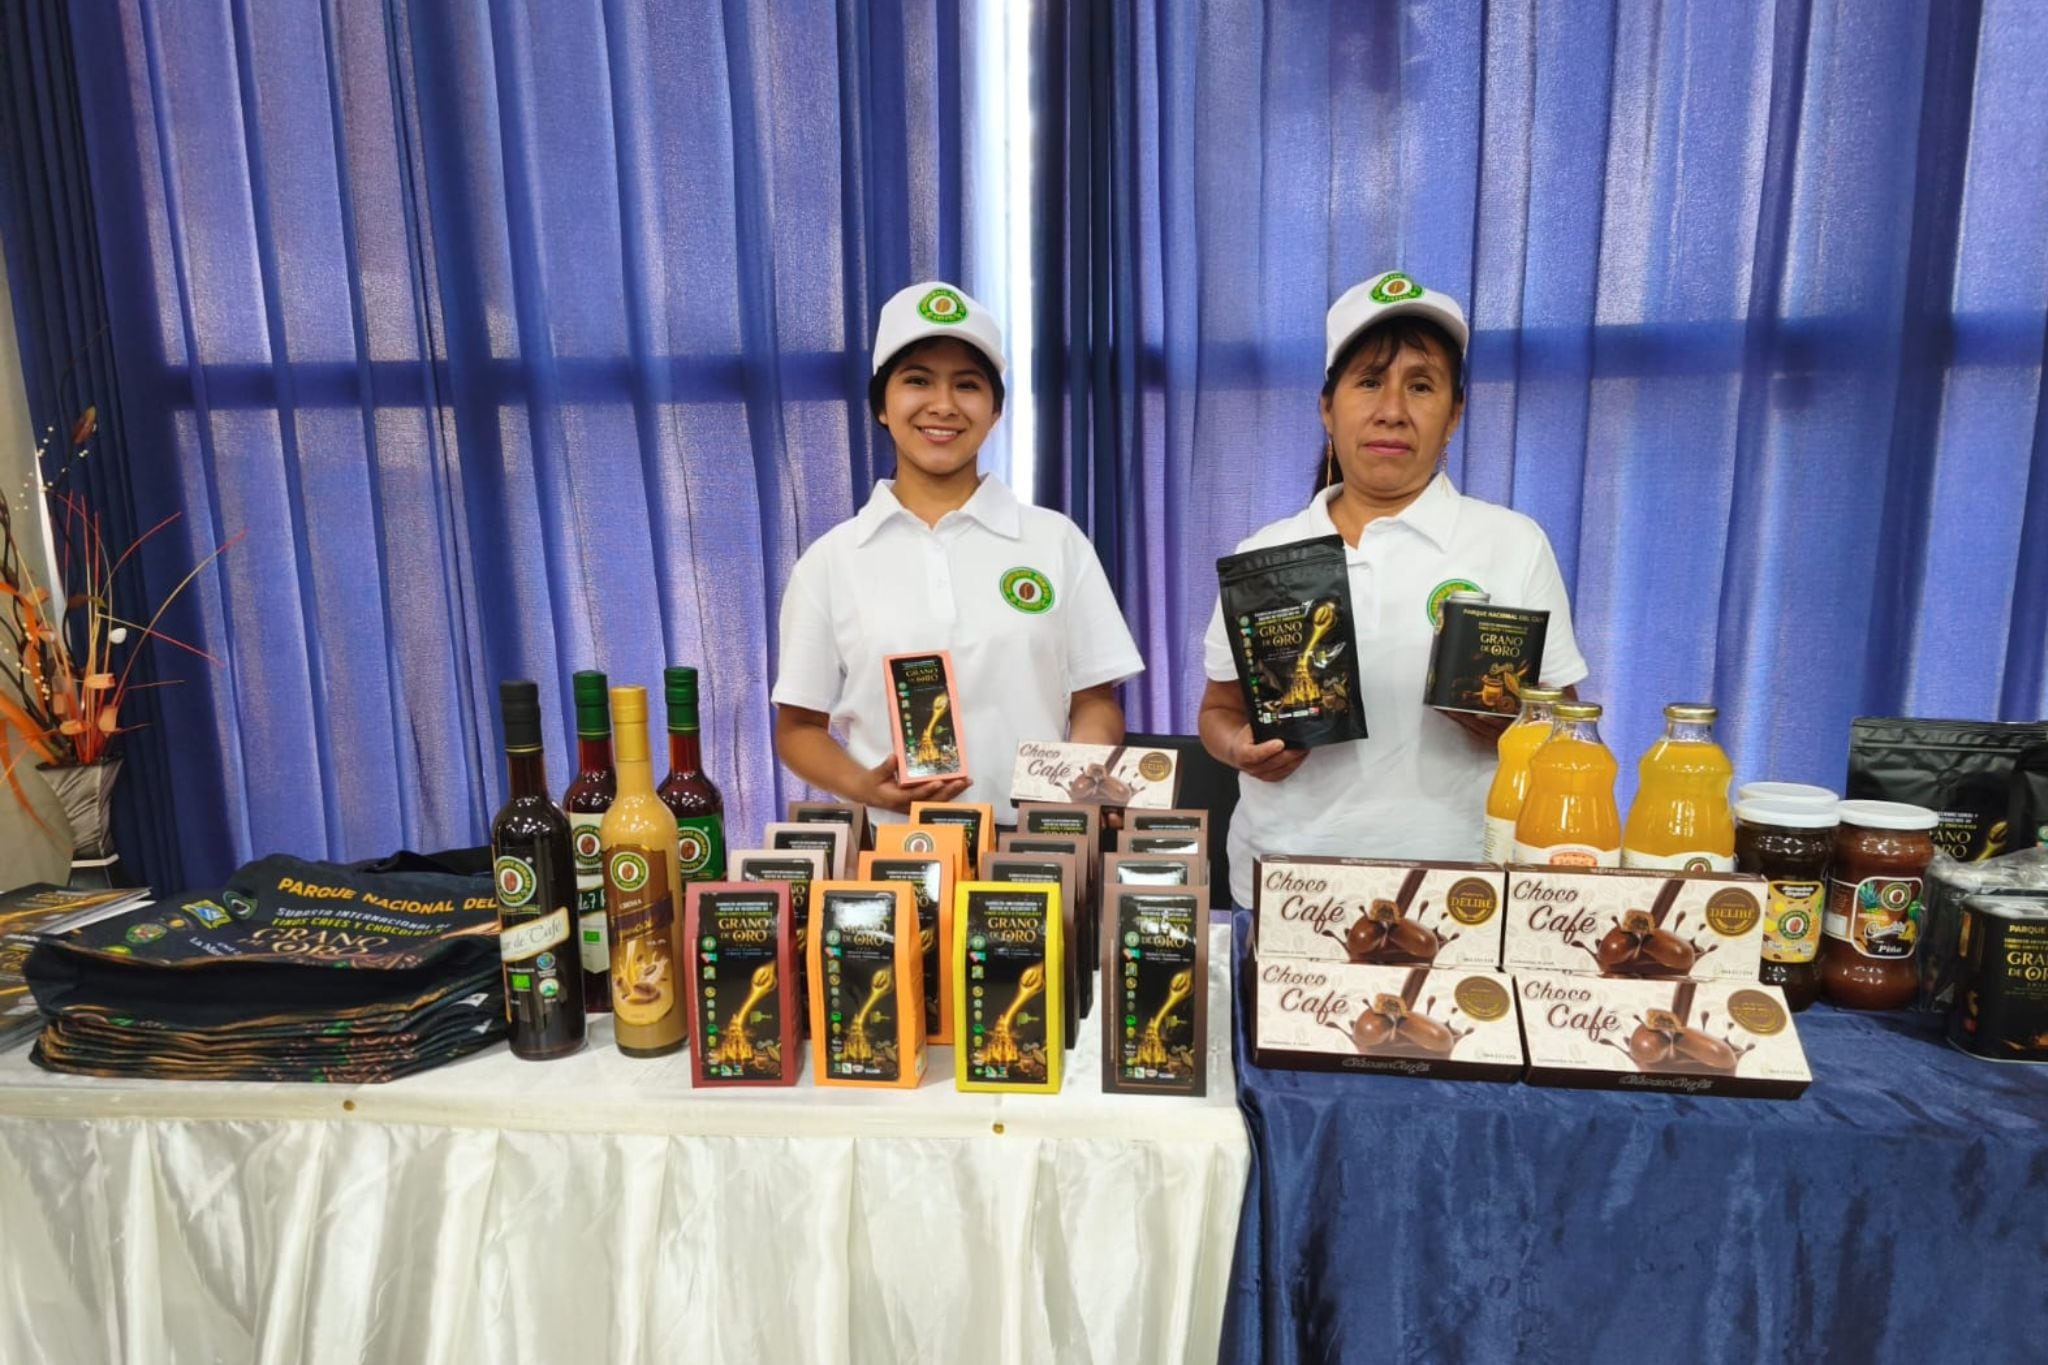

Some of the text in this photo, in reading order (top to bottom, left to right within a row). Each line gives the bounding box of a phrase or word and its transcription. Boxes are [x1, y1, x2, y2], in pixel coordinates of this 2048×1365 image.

[1259, 621, 1303, 637] GRANO
[1273, 631, 1303, 647] ORO
[1480, 633, 1523, 647] GRANO
[1491, 644, 1521, 658] ORO
[1019, 743, 1061, 759] Choco
[1027, 759, 1071, 786] Café
[1929, 830, 1971, 844] ANO
[1265, 871, 1328, 892] Choco
[278, 877, 357, 899] PARQUE
[362, 892, 455, 915] NACIONAL
[462, 897, 498, 910] DEL
[1513, 879, 1578, 902] Choco
[1280, 894, 1346, 934] Café
[353, 921, 362, 930] Y
[718, 917, 769, 930] GRANO
[988, 917, 1039, 930] GRANO
[1528, 904, 1597, 944] Café
[2009, 924, 2045, 934] PARQUE
[252, 927, 389, 948] GRANO
[732, 929, 768, 943] ORO
[853, 933, 885, 947] ORO
[1001, 929, 1037, 943] ORO
[1153, 935, 1187, 948] ORO
[2007, 951, 2048, 966] GRA
[1262, 964, 1328, 987] Choco
[1523, 980, 1592, 1002] Choco
[1279, 987, 1350, 1025] Café
[1546, 1003, 1622, 1043] Café
